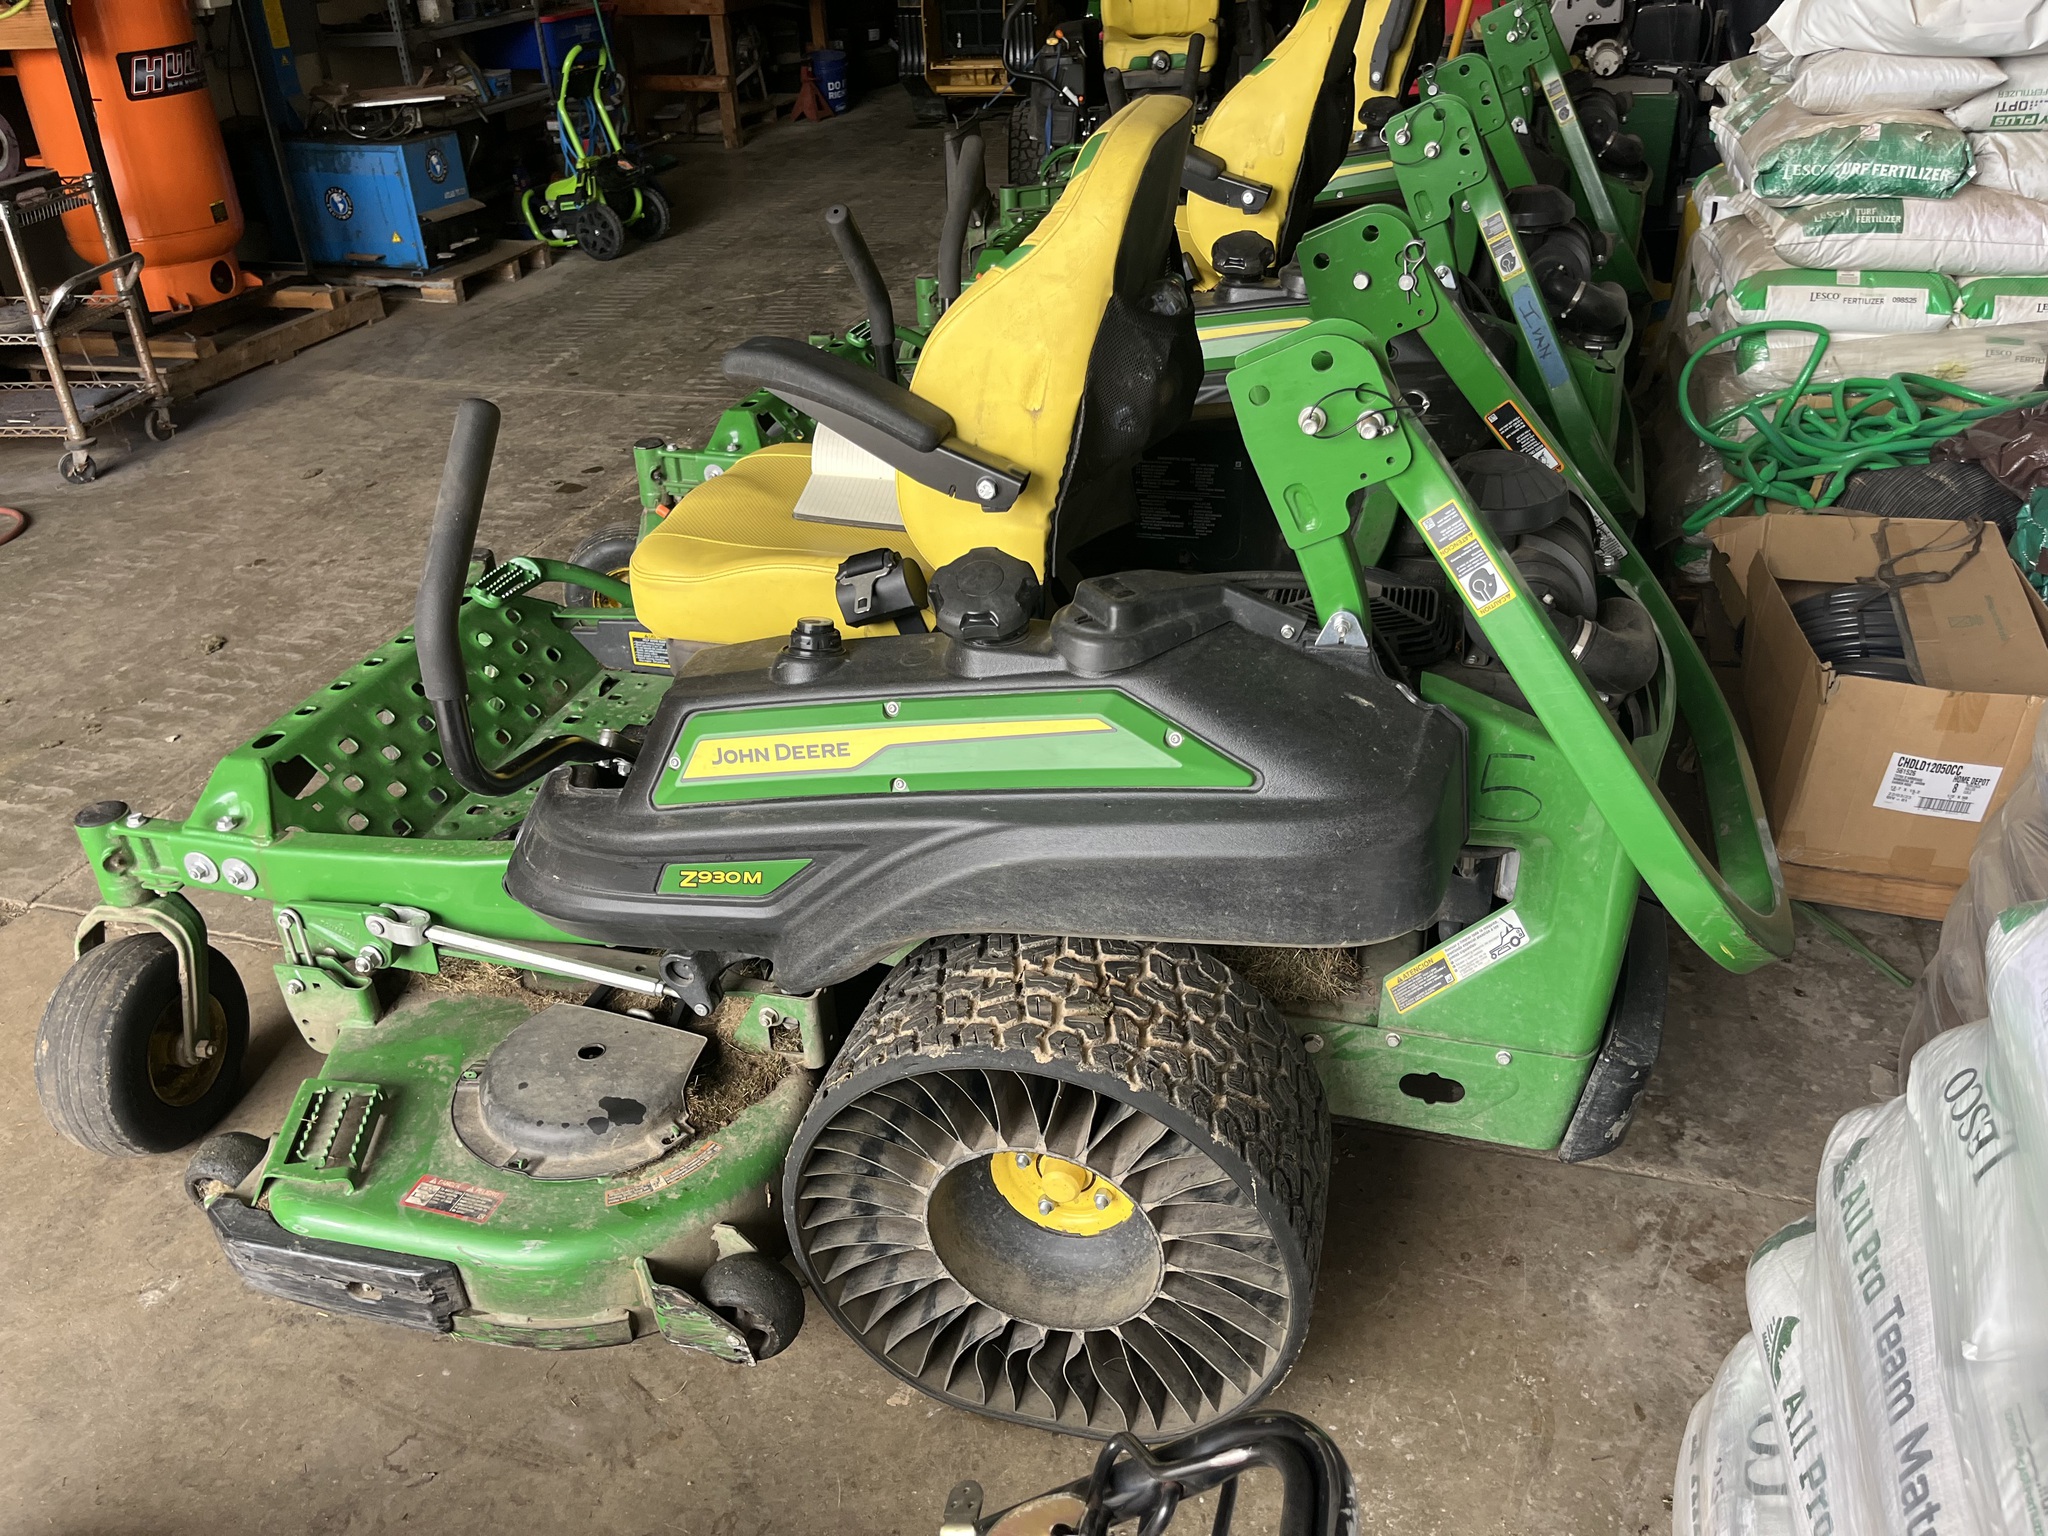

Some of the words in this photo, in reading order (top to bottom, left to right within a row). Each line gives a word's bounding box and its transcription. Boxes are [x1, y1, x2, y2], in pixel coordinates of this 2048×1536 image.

[1994, 100, 2028, 112] OPTI
[1994, 115, 2037, 126] PLUS
[1873, 164, 1953, 182] FERTILIZER
[1856, 207, 1877, 216] TURF
[1856, 215, 1902, 224] FERTILIZER
[1810, 292, 1840, 302] LESCO
[1843, 297, 1885, 305] FERTILIZER
[1480, 596, 1506, 615] CAUTION
[712, 747, 770, 765] JOHN
[774, 742, 851, 761] DEERE
[1897, 756, 1964, 776] CHDLD12050CC
[1475, 753, 1542, 823] 5
[1952, 775, 1971, 785] HOME
[1971, 777, 1990, 787] DEPOT
[1952, 783, 1959, 793] 8
[679, 870, 763, 888] Z930M
[1944, 1067, 2020, 1188] LESCO
[1840, 1179, 1875, 1244] All
[1851, 1229, 1886, 1306] Pro
[1873, 1294, 1916, 1427] Team
[1783, 1384, 1818, 1462] All
[1799, 1453, 1835, 1536] Pro
